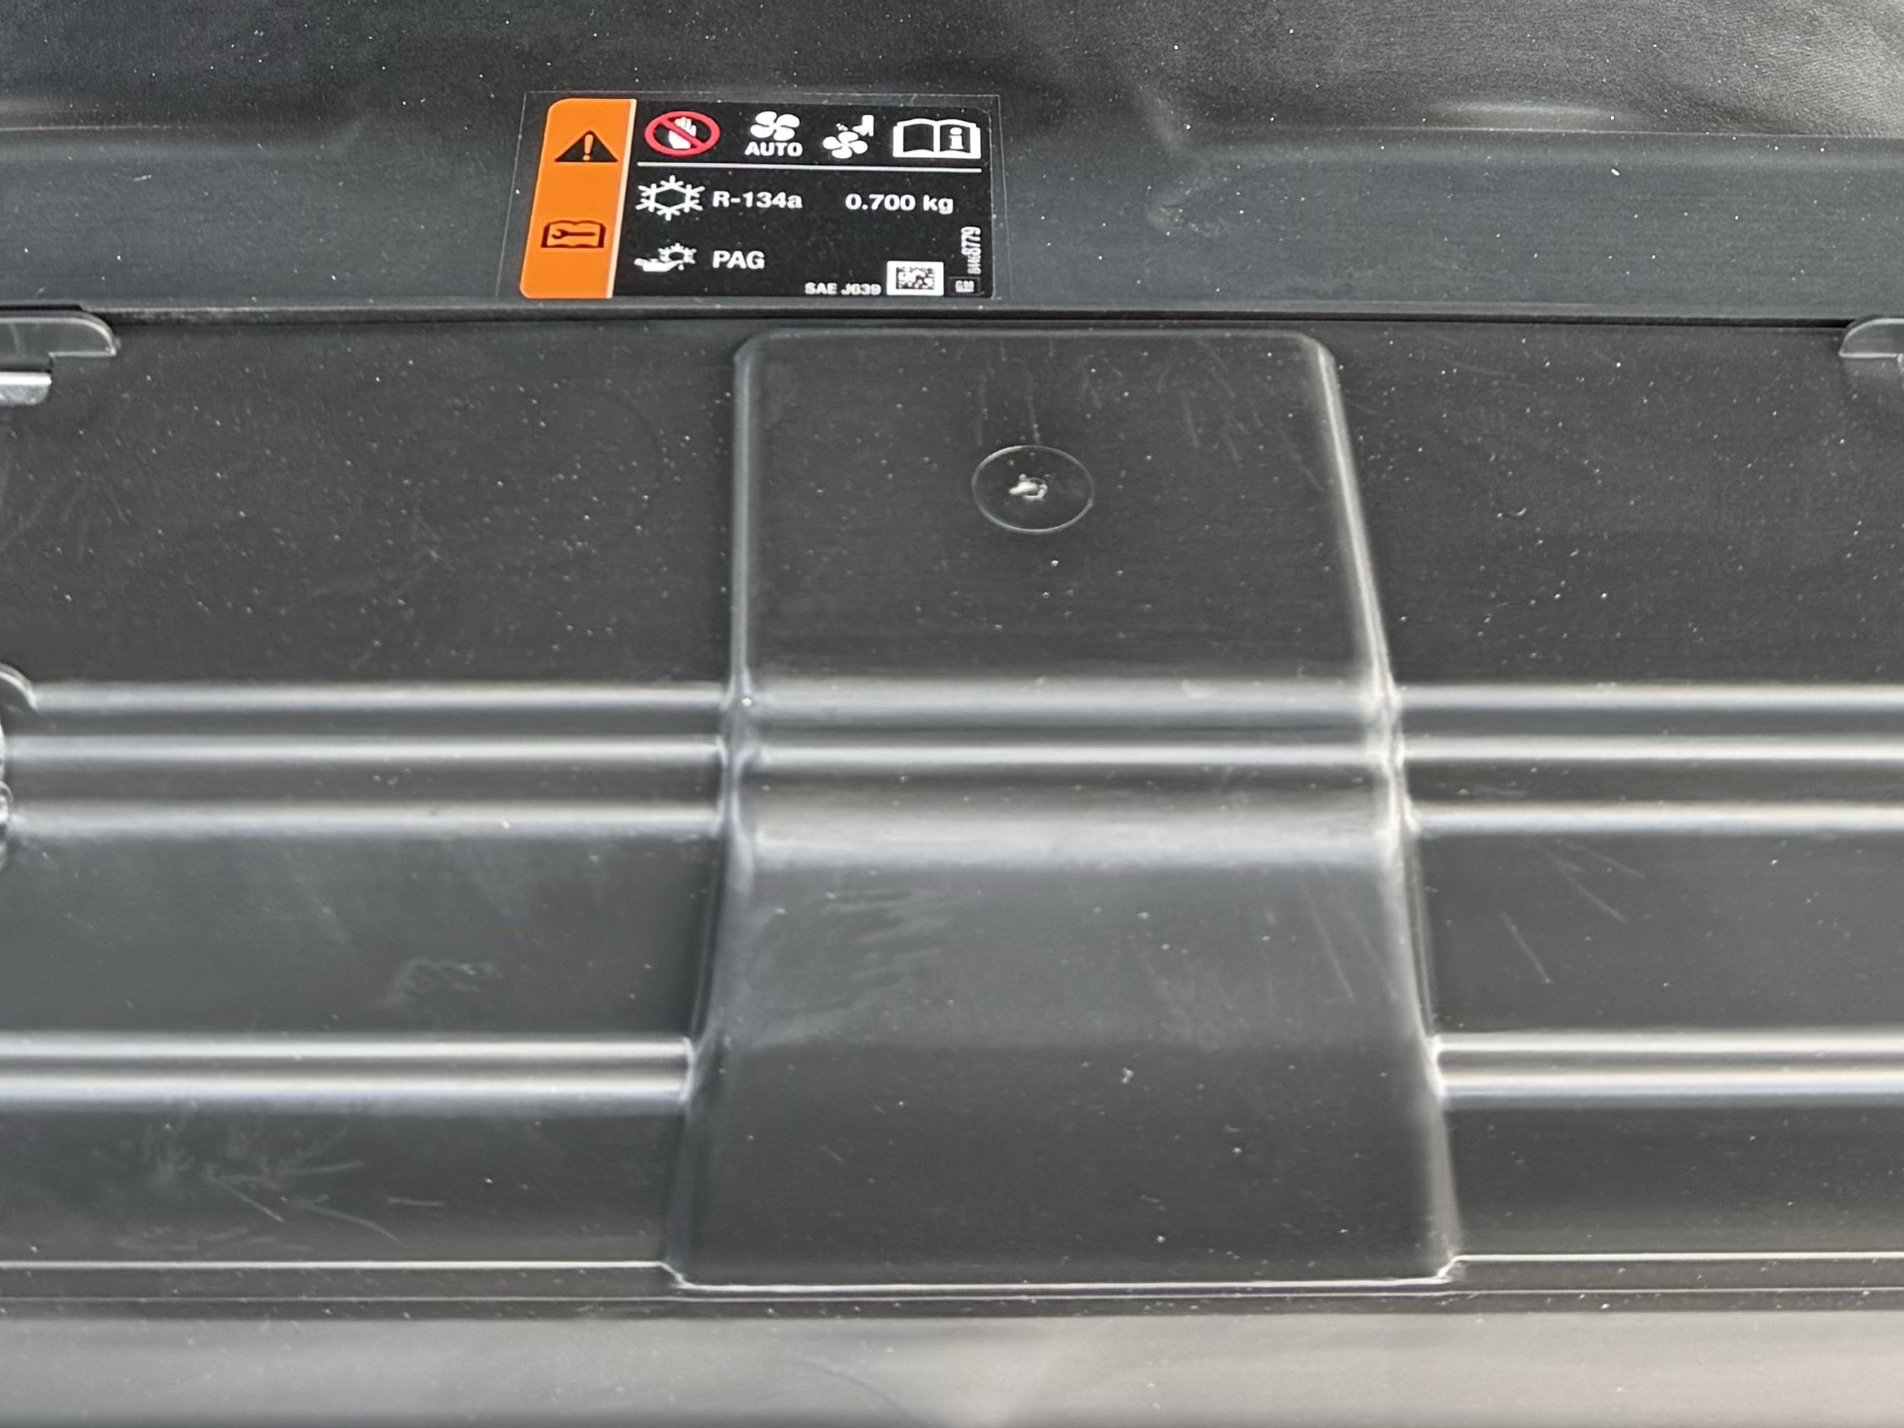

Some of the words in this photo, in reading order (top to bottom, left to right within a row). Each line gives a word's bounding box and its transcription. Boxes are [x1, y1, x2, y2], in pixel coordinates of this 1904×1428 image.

[744, 142, 803, 157] AUTO
[712, 190, 803, 209] R-134a
[845, 193, 916, 211] 0.700
[923, 194, 954, 214] kg
[712, 250, 765, 269] PAG
[804, 282, 838, 295] SAE
[841, 282, 882, 295] J639
